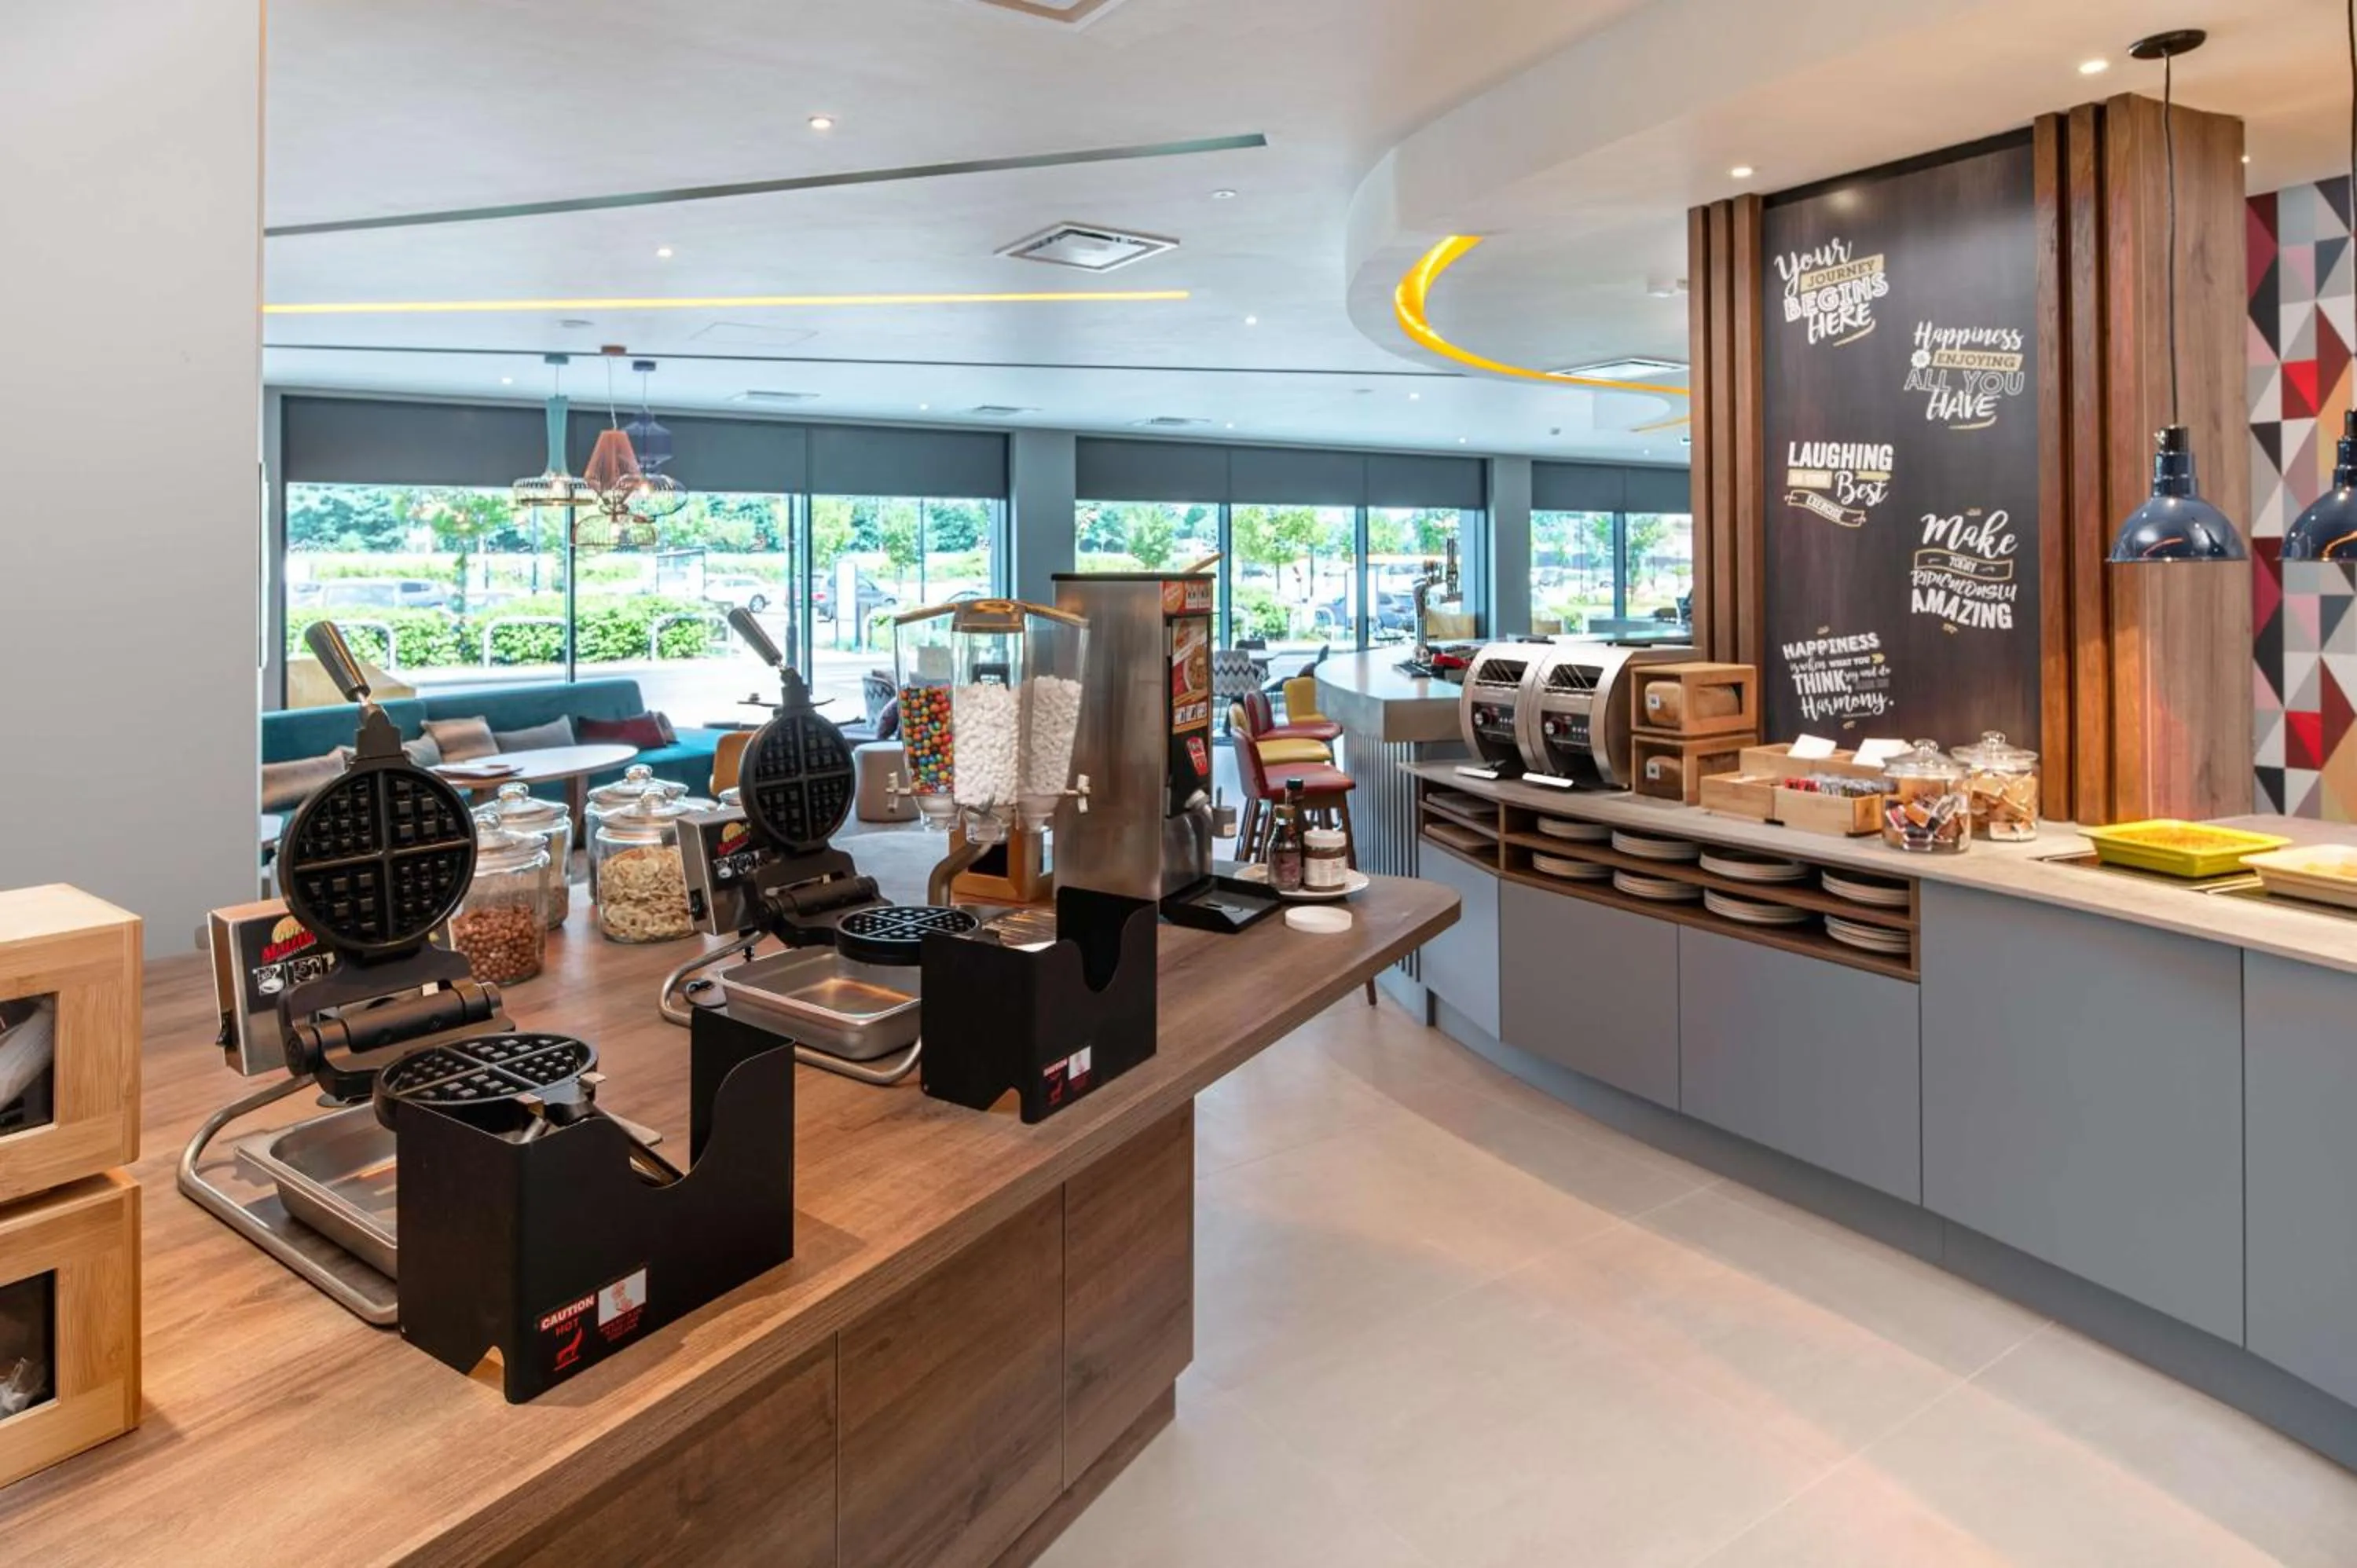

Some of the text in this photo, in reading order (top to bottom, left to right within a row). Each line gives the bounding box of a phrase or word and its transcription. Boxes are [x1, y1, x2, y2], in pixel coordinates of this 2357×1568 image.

[1774, 237, 1853, 299] Your
[1808, 259, 1876, 288] JOURNEY
[1783, 273, 1889, 323] BEGINS
[1808, 303, 1872, 344] HERE
[1914, 321, 2025, 351] Happiness
[1937, 354, 2016, 368] ENJOYING
[1904, 368, 2025, 395] ALL YOU
[1926, 390, 2001, 420] HAVE
[1787, 441, 1893, 471] LAUGHING
[1835, 471, 1888, 507] Best
[1920, 510, 2018, 559] Make
[1912, 588, 2014, 629] AMAZING
[1783, 632, 1881, 660] HAPPINESS
[1791, 669, 1852, 695] THINK,
[1801, 691, 1894, 721] Harmony.
[540, 1295, 596, 1332] CAUTION
[555, 1317, 579, 1337] HOT
